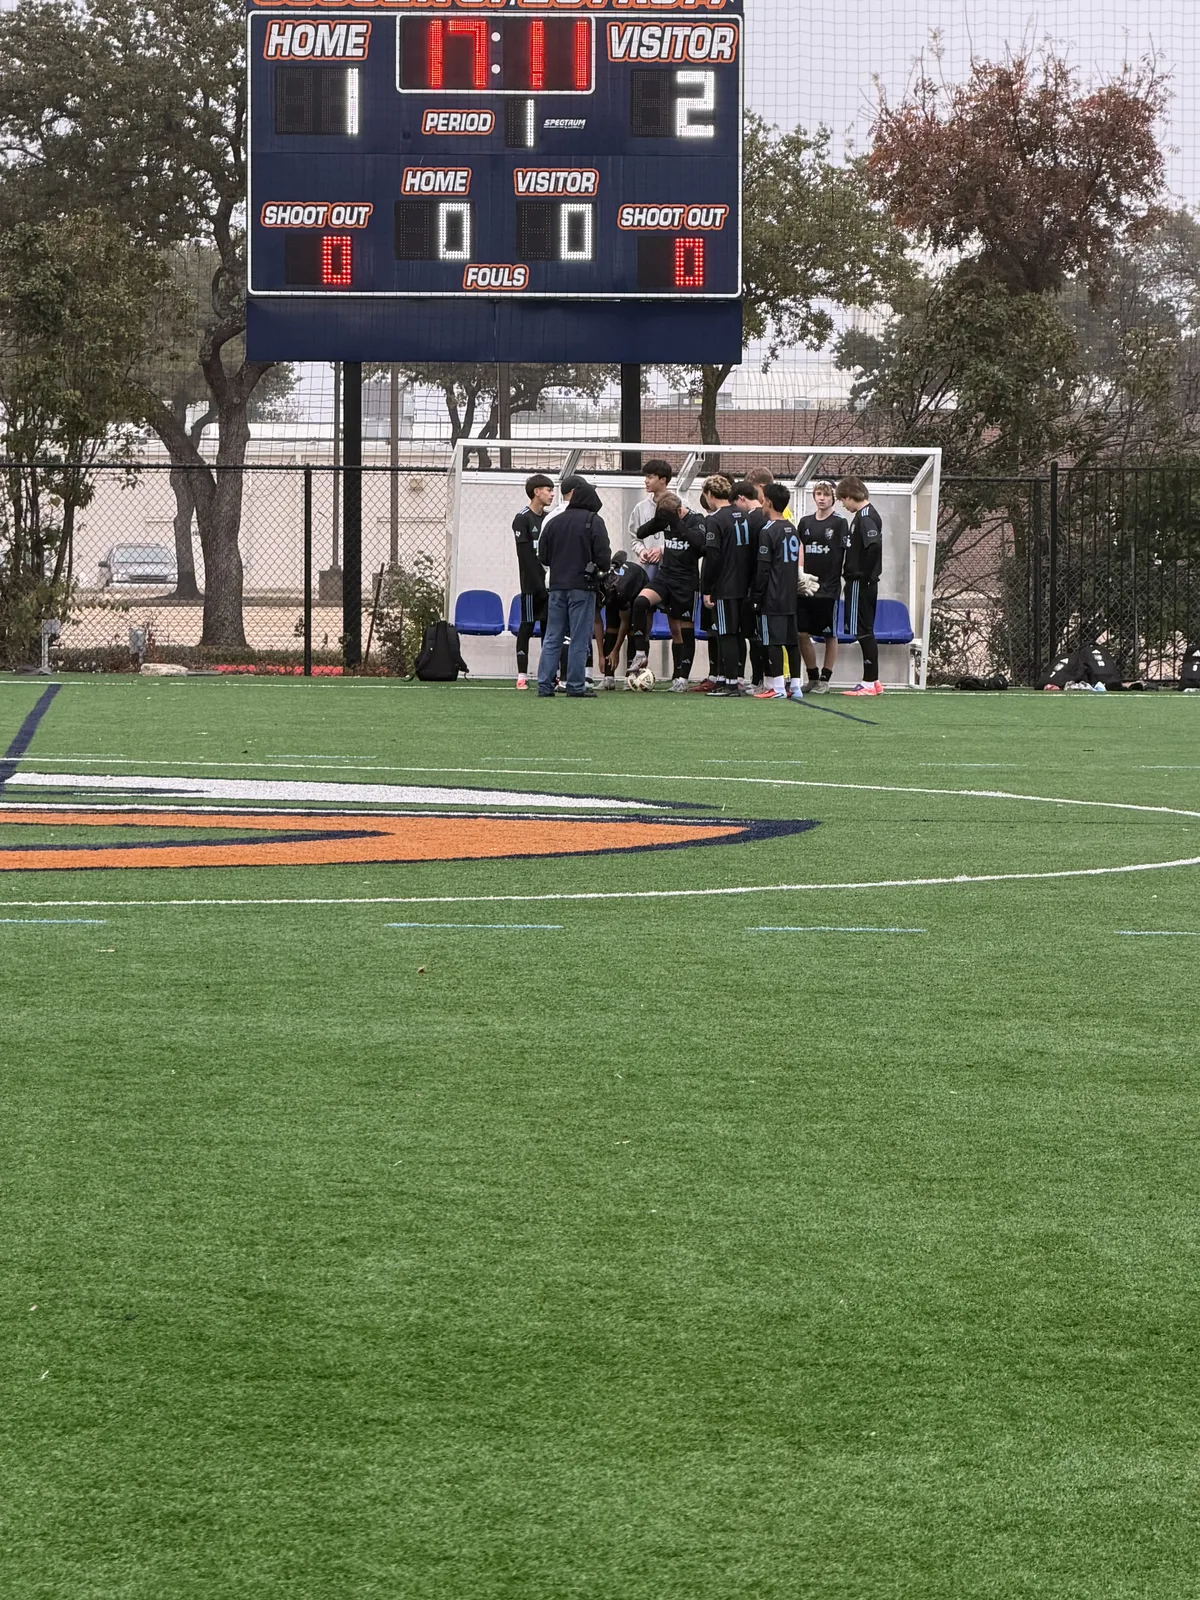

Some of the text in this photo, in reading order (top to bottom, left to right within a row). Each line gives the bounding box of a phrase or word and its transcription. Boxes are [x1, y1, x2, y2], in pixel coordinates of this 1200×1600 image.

[266, 22, 369, 58] HOME
[609, 25, 735, 61] VISITOR
[347, 67, 360, 135] 1
[675, 70, 716, 138] 2
[424, 112, 493, 133] PERIOD
[526, 98, 535, 148] 1
[543, 118, 587, 127] SPECTRUM
[404, 170, 470, 192] HOME
[516, 171, 597, 193] VISITOR
[264, 205, 371, 226] SHOOT OUT
[438, 202, 471, 260] 0
[560, 202, 593, 260] 0
[620, 207, 726, 227] SHOOT OUT
[322, 235, 353, 285] 0
[674, 237, 705, 287] 0
[465, 267, 526, 287] FOULS
[733, 518, 750, 546] 11
[781, 534, 799, 563] 19
